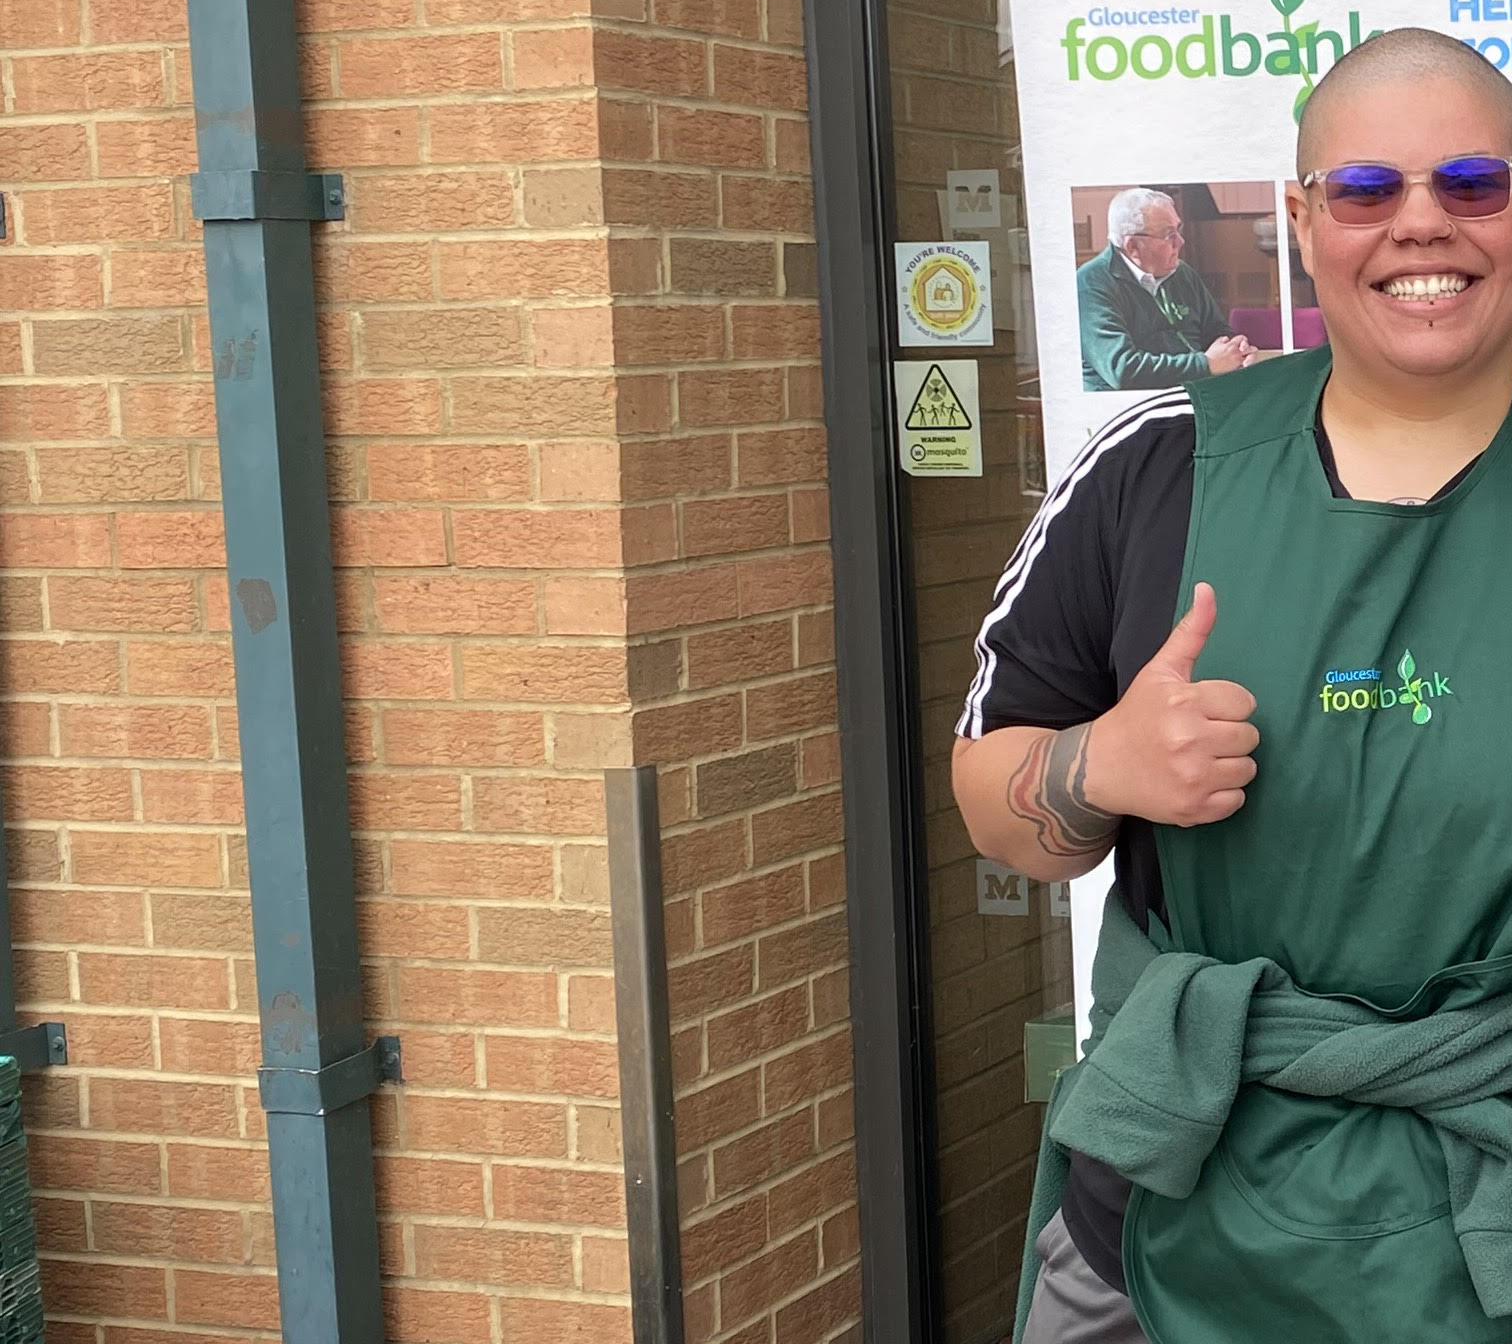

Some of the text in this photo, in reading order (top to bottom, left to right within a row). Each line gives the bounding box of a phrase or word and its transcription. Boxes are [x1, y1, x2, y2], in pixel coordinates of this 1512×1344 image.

[1088, 6, 1200, 26] Gloucester
[905, 246, 981, 274] YOU'RE WELCOME
